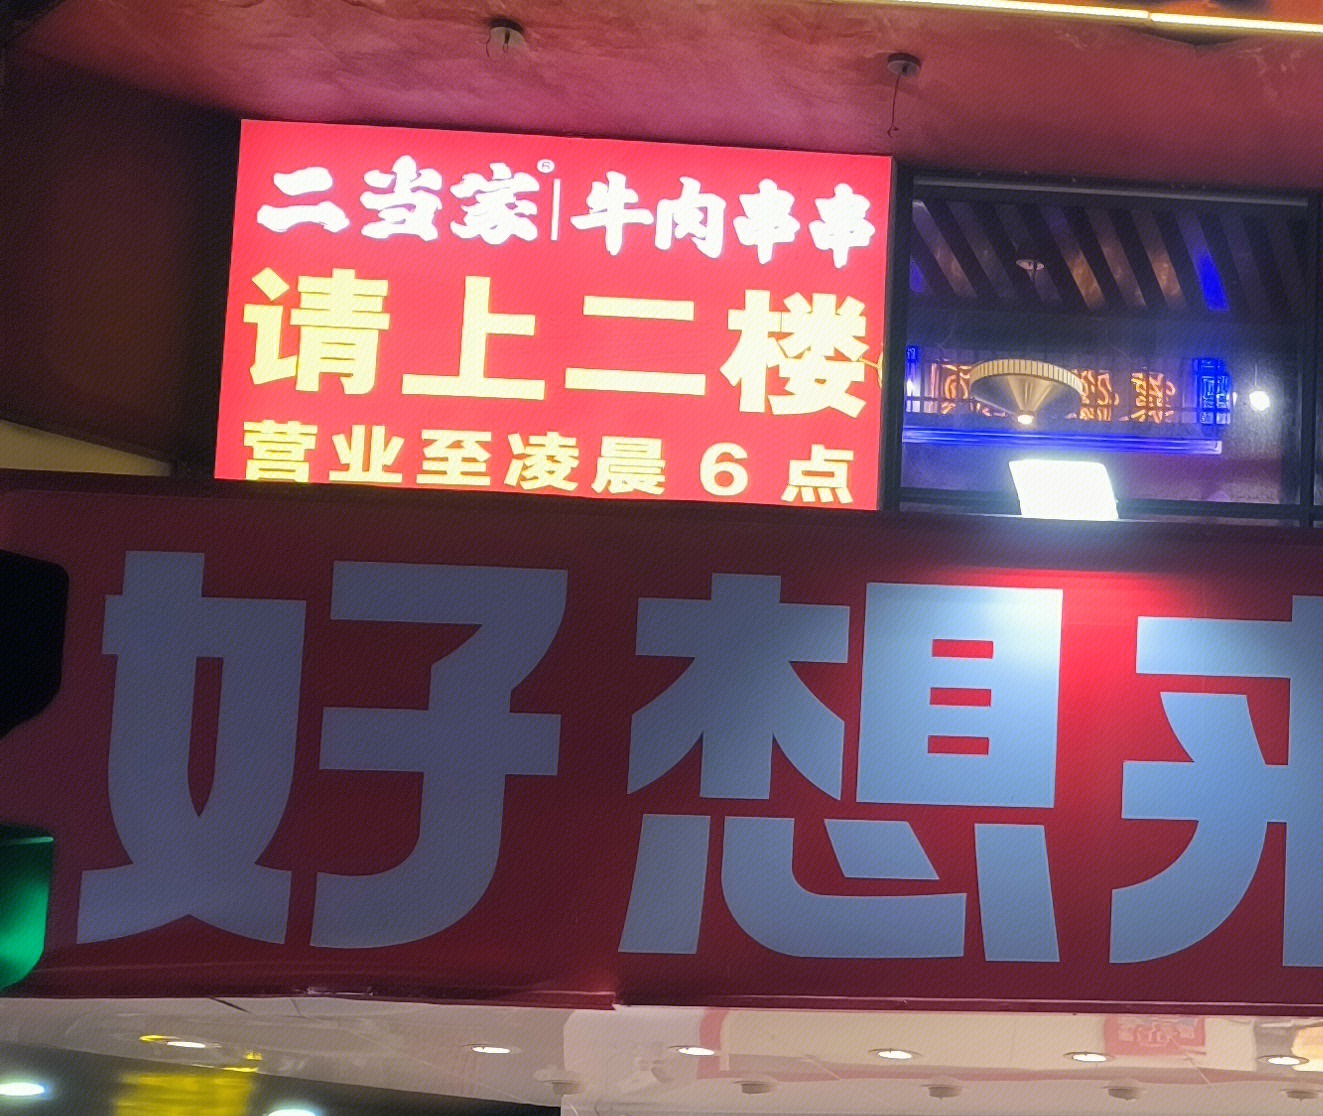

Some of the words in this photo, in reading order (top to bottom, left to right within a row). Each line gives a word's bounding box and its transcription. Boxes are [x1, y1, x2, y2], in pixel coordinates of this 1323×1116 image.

[256, 156, 539, 244] 二当家
[573, 172, 873, 267] 牛肉串串
[242, 268, 870, 418] 请上二楼
